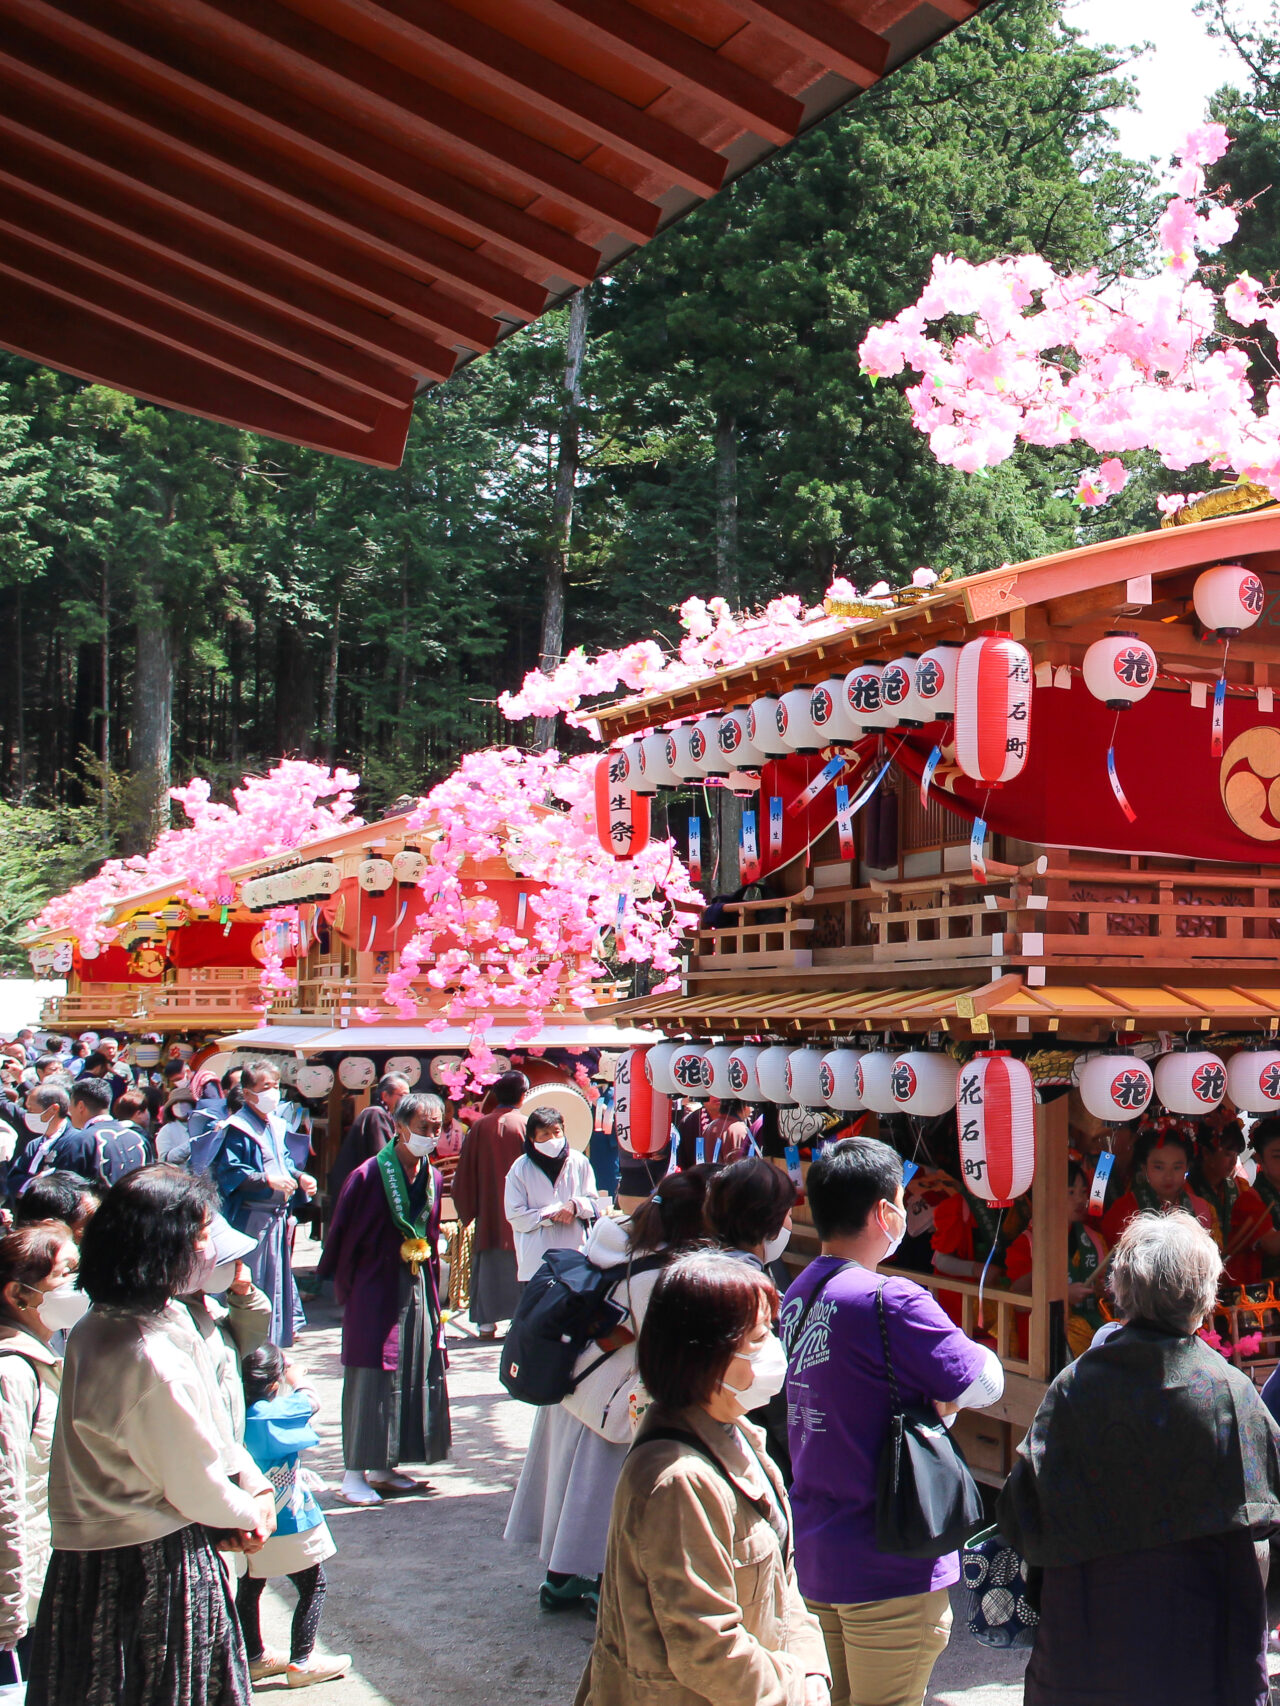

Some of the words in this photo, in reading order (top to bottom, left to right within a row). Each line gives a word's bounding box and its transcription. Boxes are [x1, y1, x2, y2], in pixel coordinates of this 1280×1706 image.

[1243, 579, 1263, 612] 花
[916, 662, 938, 695] 花
[1118, 650, 1150, 684] 花
[851, 678, 881, 709] 花
[881, 669, 904, 702] 花
[810, 691, 827, 722] 花
[1006, 656, 1030, 760] 花石町
[718, 721, 736, 749] 花
[62, 943, 71, 968] 大工町
[677, 1058, 701, 1084] 花
[728, 1061, 743, 1088] 花
[891, 1064, 911, 1099] 花
[1196, 1066, 1225, 1099] 花
[614, 1059, 631, 1141] 花石町
[1114, 1073, 1149, 1107] 花
[959, 1074, 987, 1181] 花石町
[1085, 1253, 1097, 1268] 花
